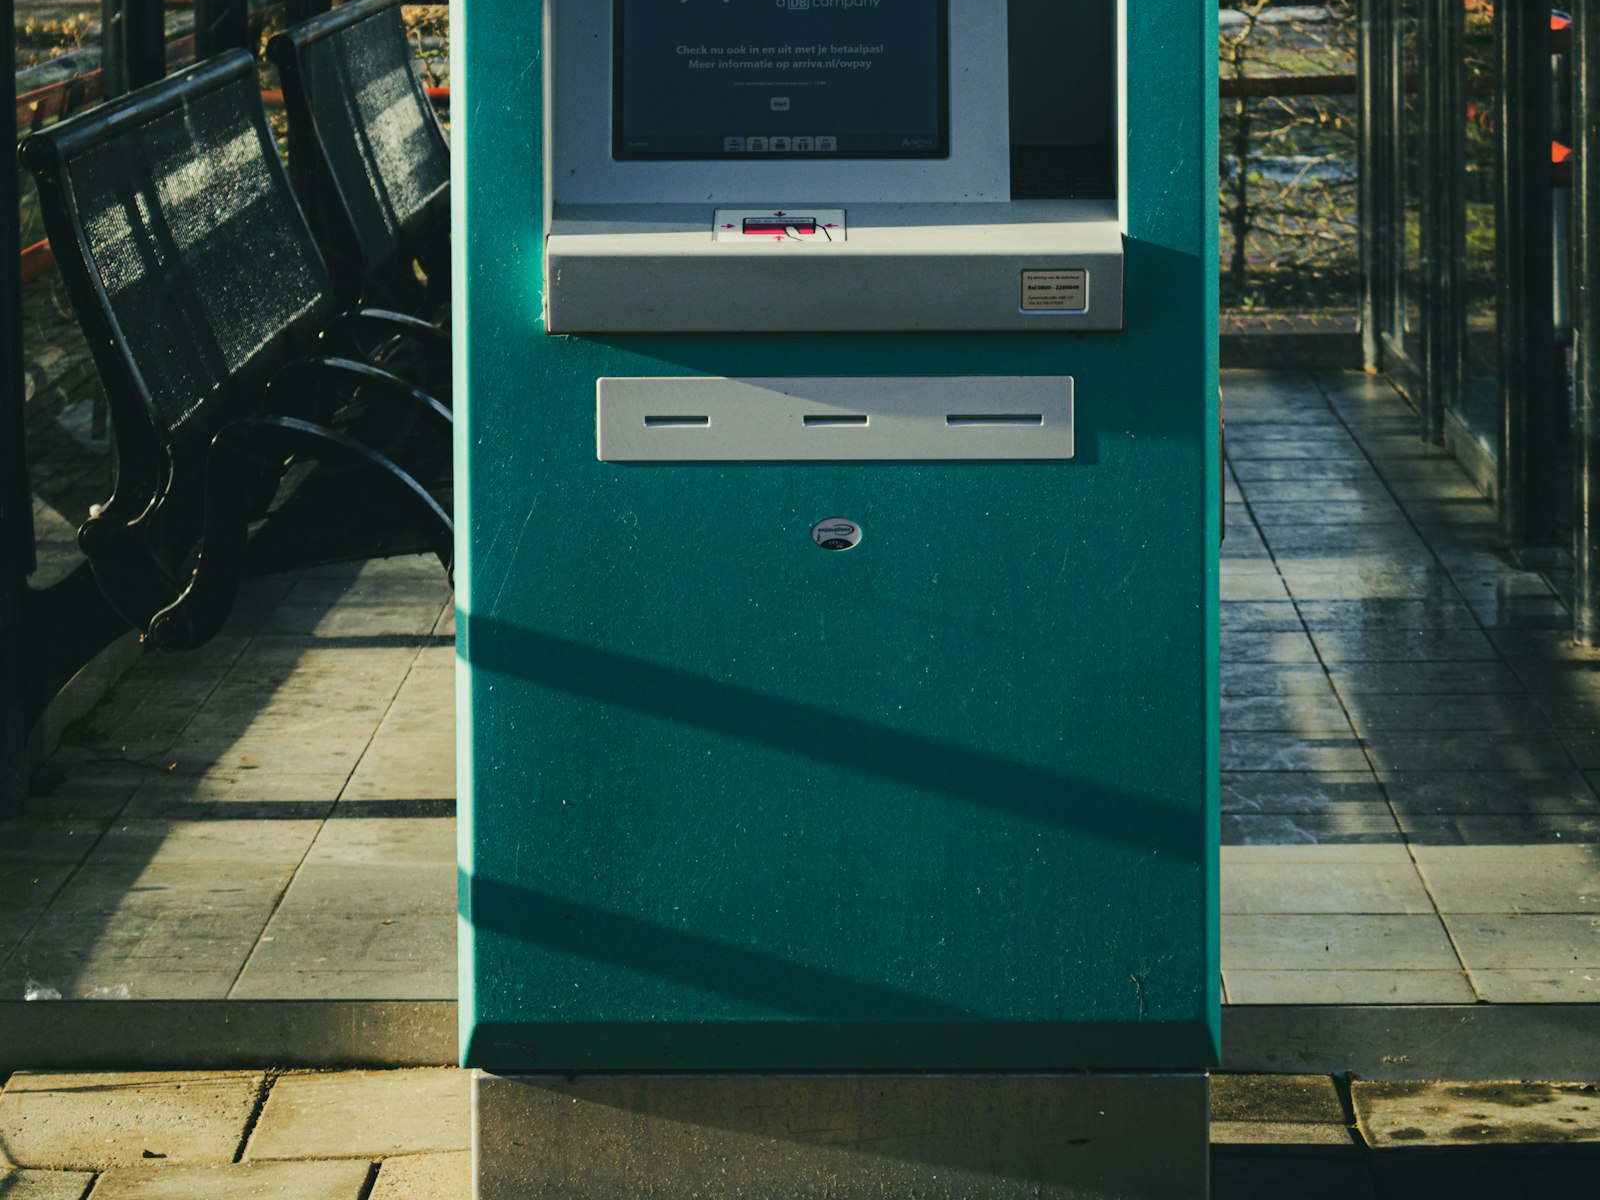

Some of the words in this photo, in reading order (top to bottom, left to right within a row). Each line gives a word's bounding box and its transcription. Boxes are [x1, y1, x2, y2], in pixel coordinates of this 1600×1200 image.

[676, 45, 708, 55] Check
[710, 46, 724, 55] nu
[726, 45, 747, 55] ook
[749, 45, 760, 55] in
[762, 46, 775, 54] en
[777, 44, 792, 54] uit
[794, 45, 816, 54] met
[817, 44, 828, 56] je
[830, 44, 884, 56] betaalpas!
[688, 60, 715, 69] Meer
[718, 59, 774, 69] informatie
[776, 61, 790, 71] op
[792, 59, 872, 71] arriva.nl/ovpay
